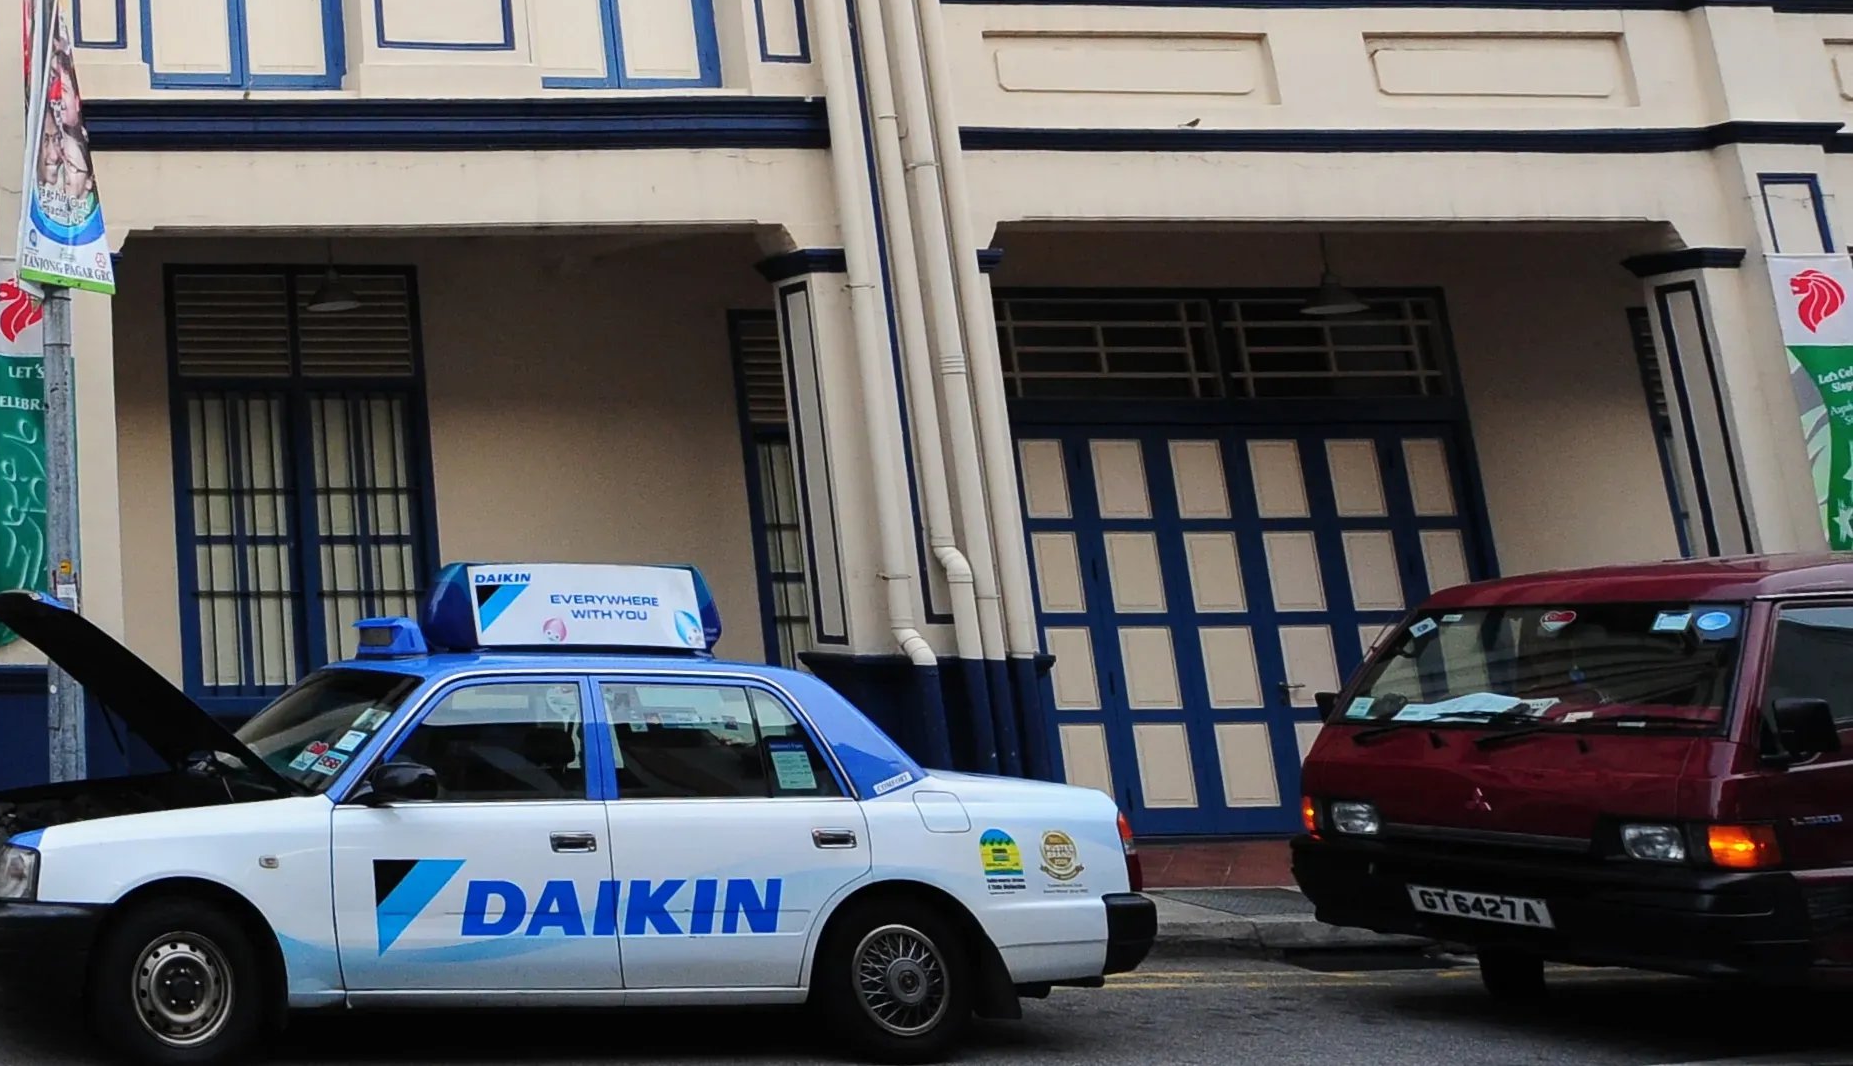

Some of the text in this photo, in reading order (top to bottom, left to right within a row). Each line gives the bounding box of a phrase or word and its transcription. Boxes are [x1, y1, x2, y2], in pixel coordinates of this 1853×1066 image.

[23, 253, 63, 272] TANJONG
[64, 263, 94, 279] PAGAR
[94, 269, 113, 282] GRC
[8, 364, 45, 379] LET'S
[475, 573, 531, 583] DAIKIN
[550, 594, 660, 607] EVERYWHERE
[571, 609, 648, 621] WITH YOU
[876, 774, 908, 794] COMFORT
[462, 877, 783, 937] DAIKIN
[1419, 890, 1541, 925] GT6427A
